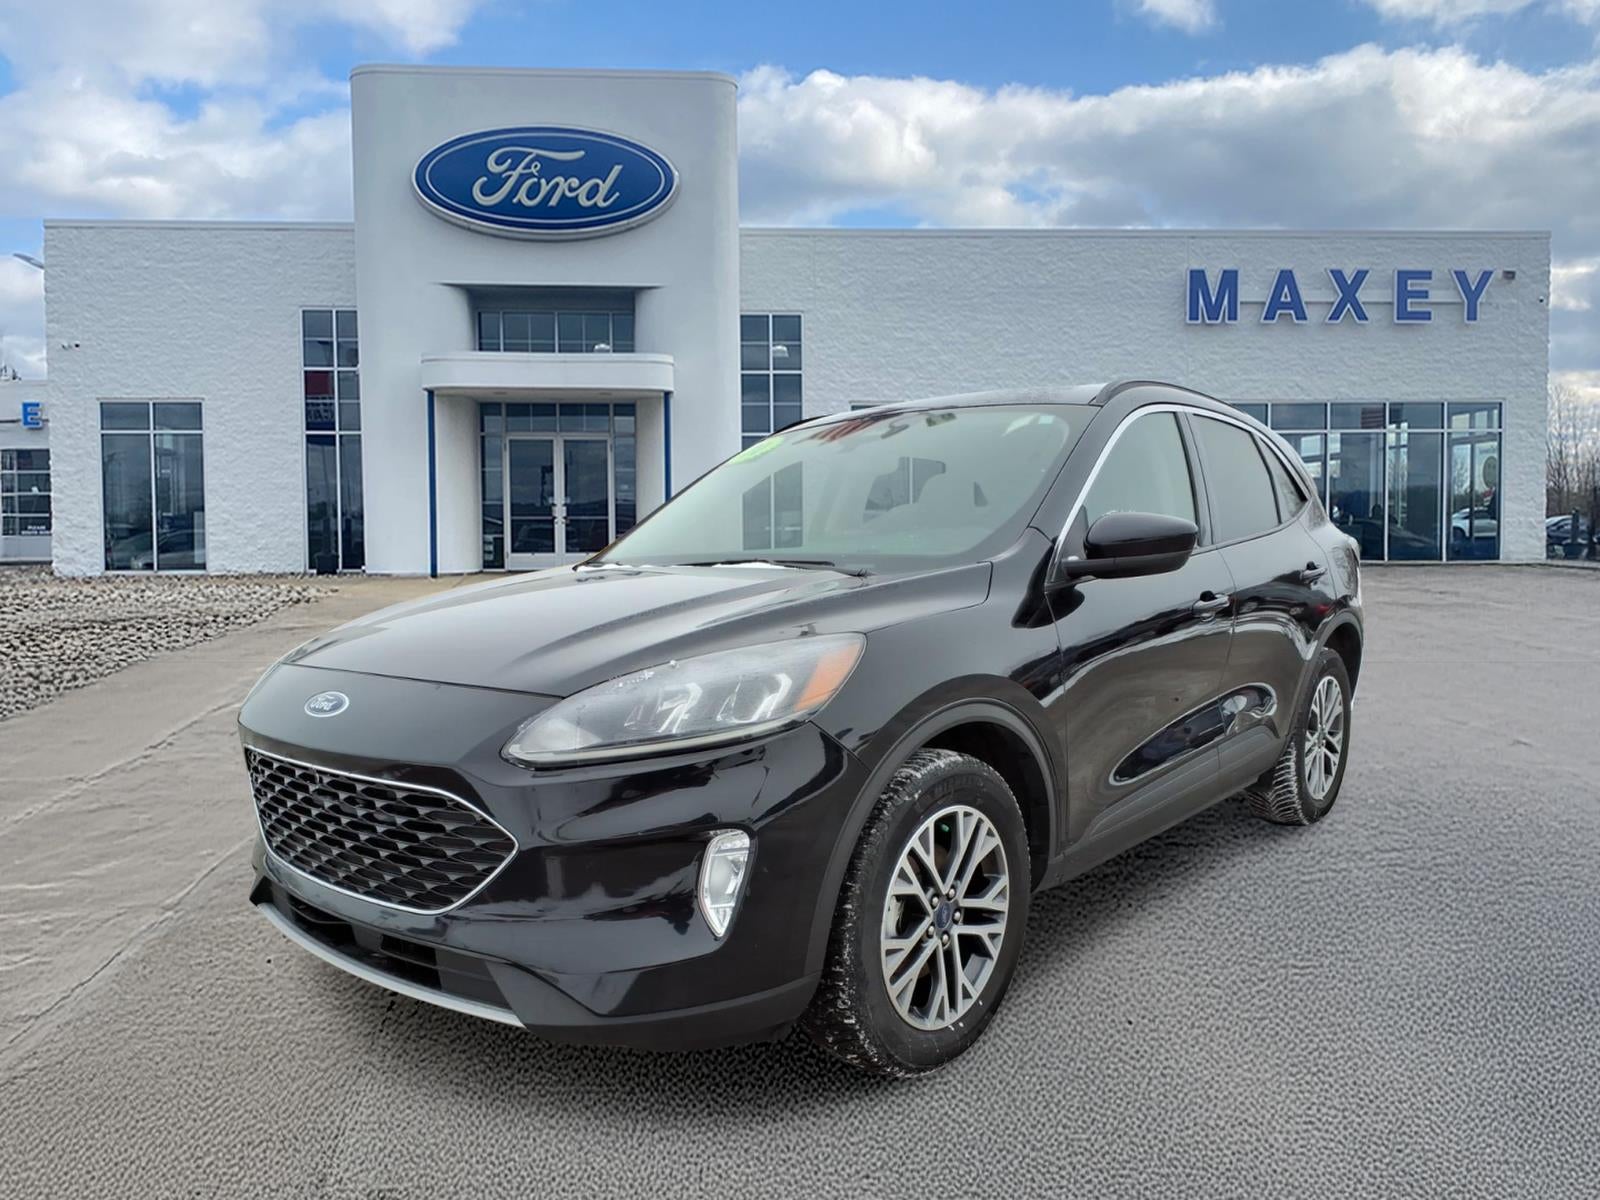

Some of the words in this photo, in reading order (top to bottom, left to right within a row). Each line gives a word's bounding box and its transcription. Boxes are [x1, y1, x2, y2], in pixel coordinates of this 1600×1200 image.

[472, 146, 623, 207] Ford
[1186, 268, 1495, 325] MAXEY
[309, 694, 338, 711] Ford
